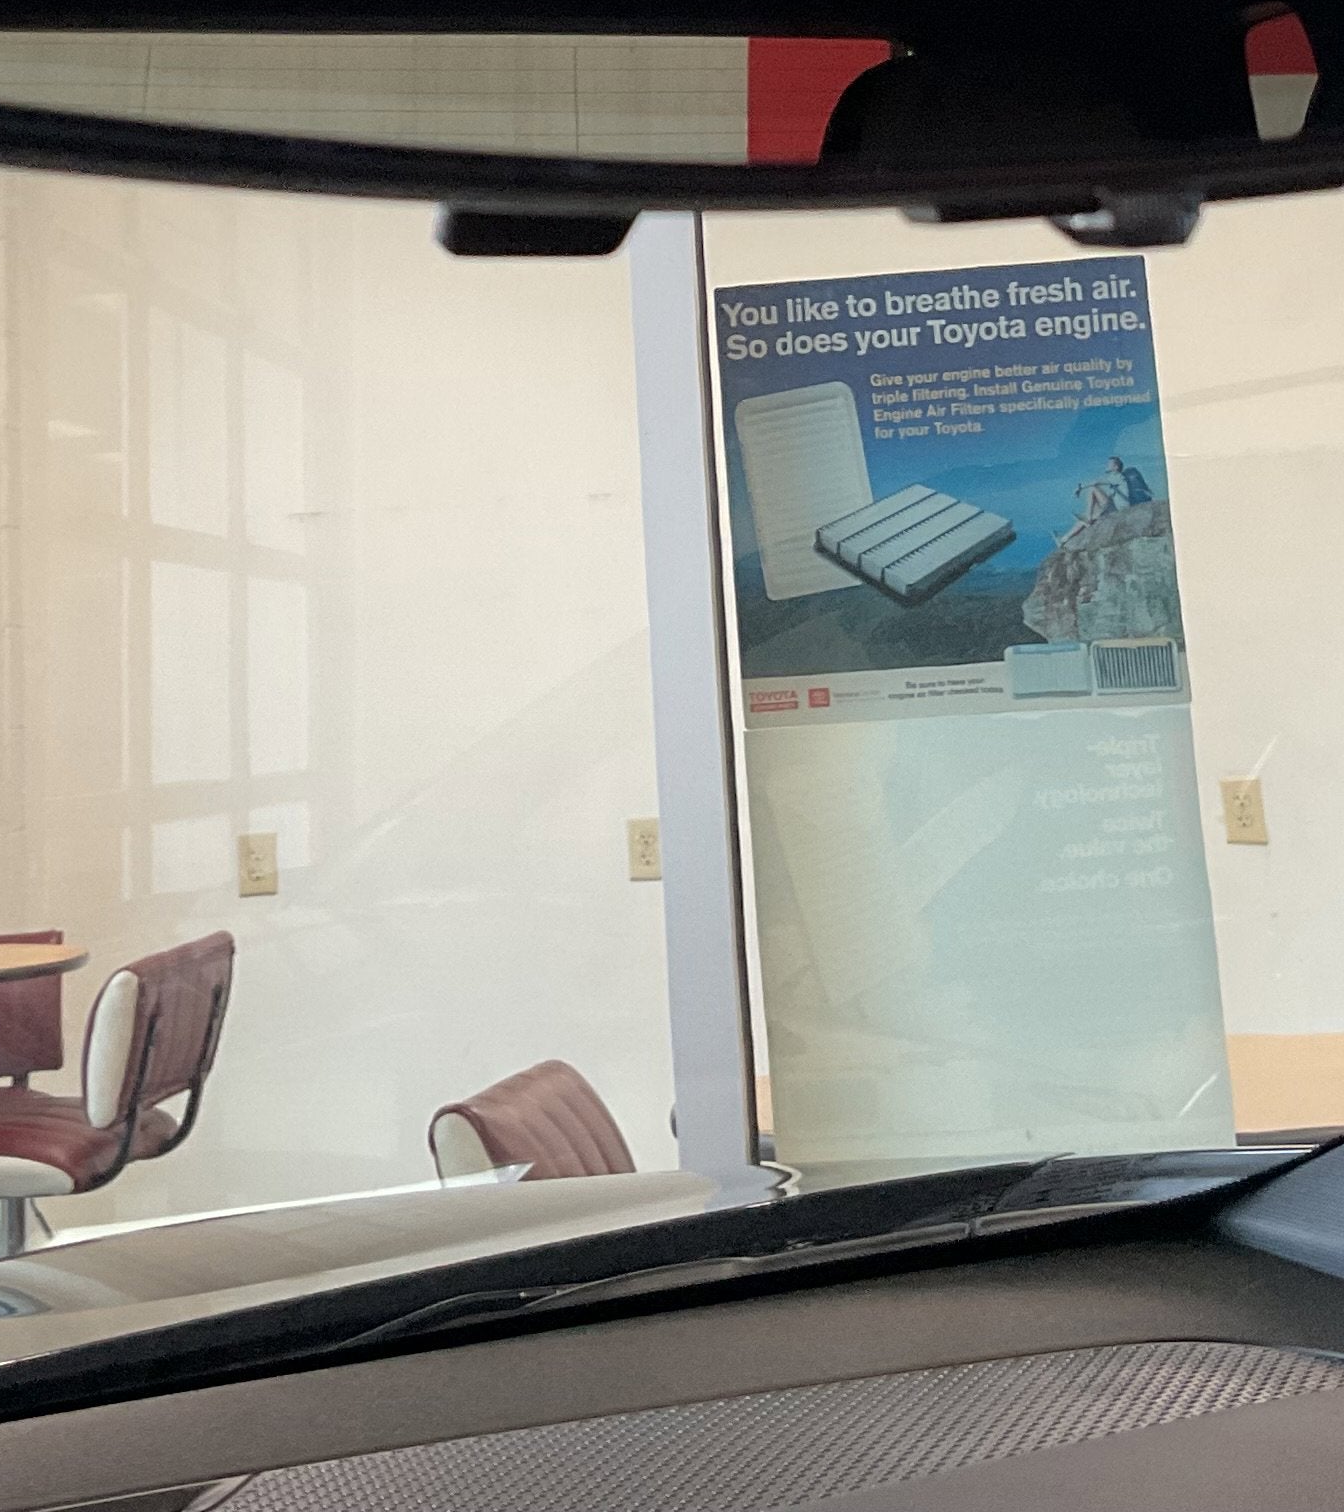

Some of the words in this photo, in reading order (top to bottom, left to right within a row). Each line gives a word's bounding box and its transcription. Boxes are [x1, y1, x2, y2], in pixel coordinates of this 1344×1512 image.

[721, 302, 778, 328] You
[786, 297, 840, 323] like
[845, 294, 877, 317] to
[885, 285, 1000, 316] breathe
[1007, 276, 1083, 306] fresh
[1091, 274, 1138, 301] air.
[726, 334, 768, 360] So
[775, 331, 848, 357] does
[855, 326, 921, 356] your
[926, 316, 1027, 348] Toyota
[1034, 308, 1146, 339] engine.
[870, 373, 903, 387] Give
[906, 372, 939, 387] your
[942, 368, 990, 383] engine
[994, 364, 1037, 378] better
[1041, 362, 1060, 375] air
[1063, 358, 1112, 375] quality
[1116, 358, 1133, 372] by
[872, 390, 909, 405] triple
[973, 381, 1018, 397] Install
[1021, 379, 1083, 393] Genuine
[1086, 376, 1135, 390] Toyota
[873, 408, 923, 423] Engine
[926, 405, 946, 417] Air
[950, 403, 995, 416] Filters
[999, 396, 1080, 414] specifically
[1083, 389, 1152, 407] designed
[874, 426, 895, 439] for
[898, 425, 930, 439] your
[748, 690, 799, 702] TOYOTA
